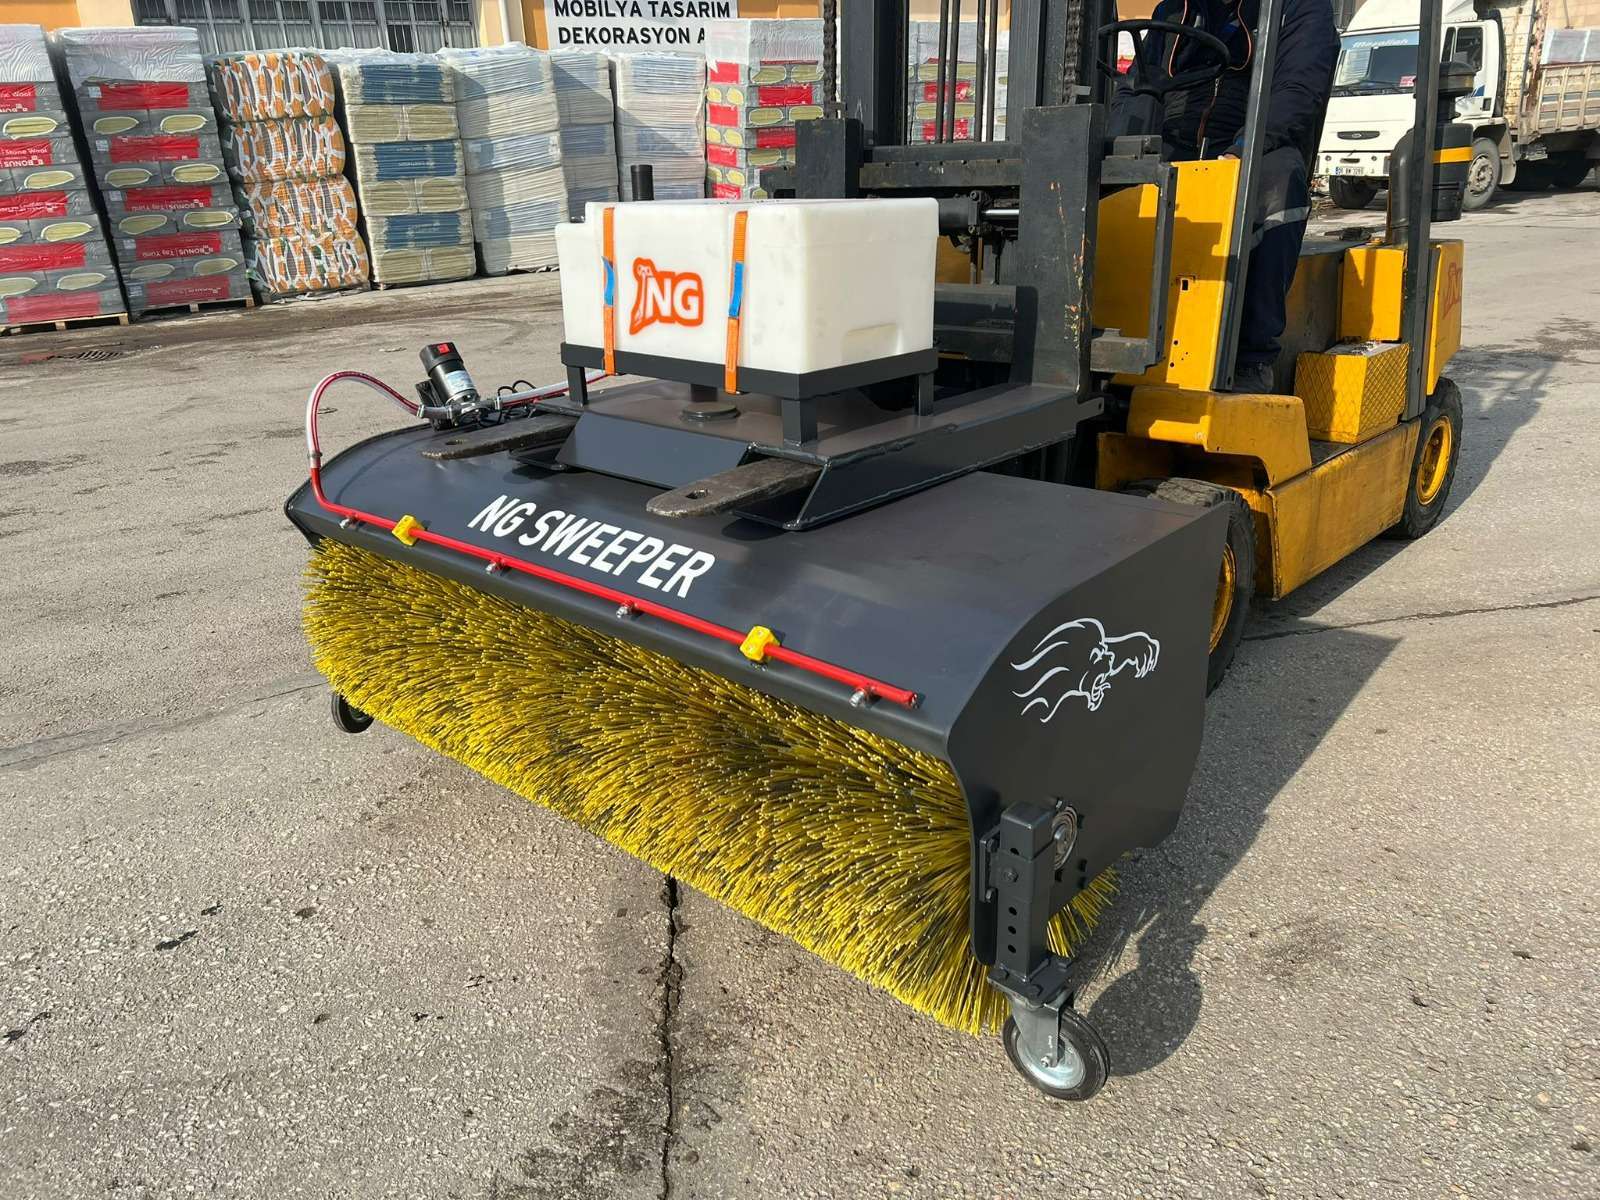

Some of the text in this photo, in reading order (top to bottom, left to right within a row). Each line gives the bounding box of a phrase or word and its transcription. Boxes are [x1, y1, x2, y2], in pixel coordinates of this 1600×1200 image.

[650, 0, 730, 18] TASARIM
[558, 27, 690, 44] DEKORASYON
[645, 270, 703, 326] NG
[467, 494, 716, 599] NG SWEEPER
